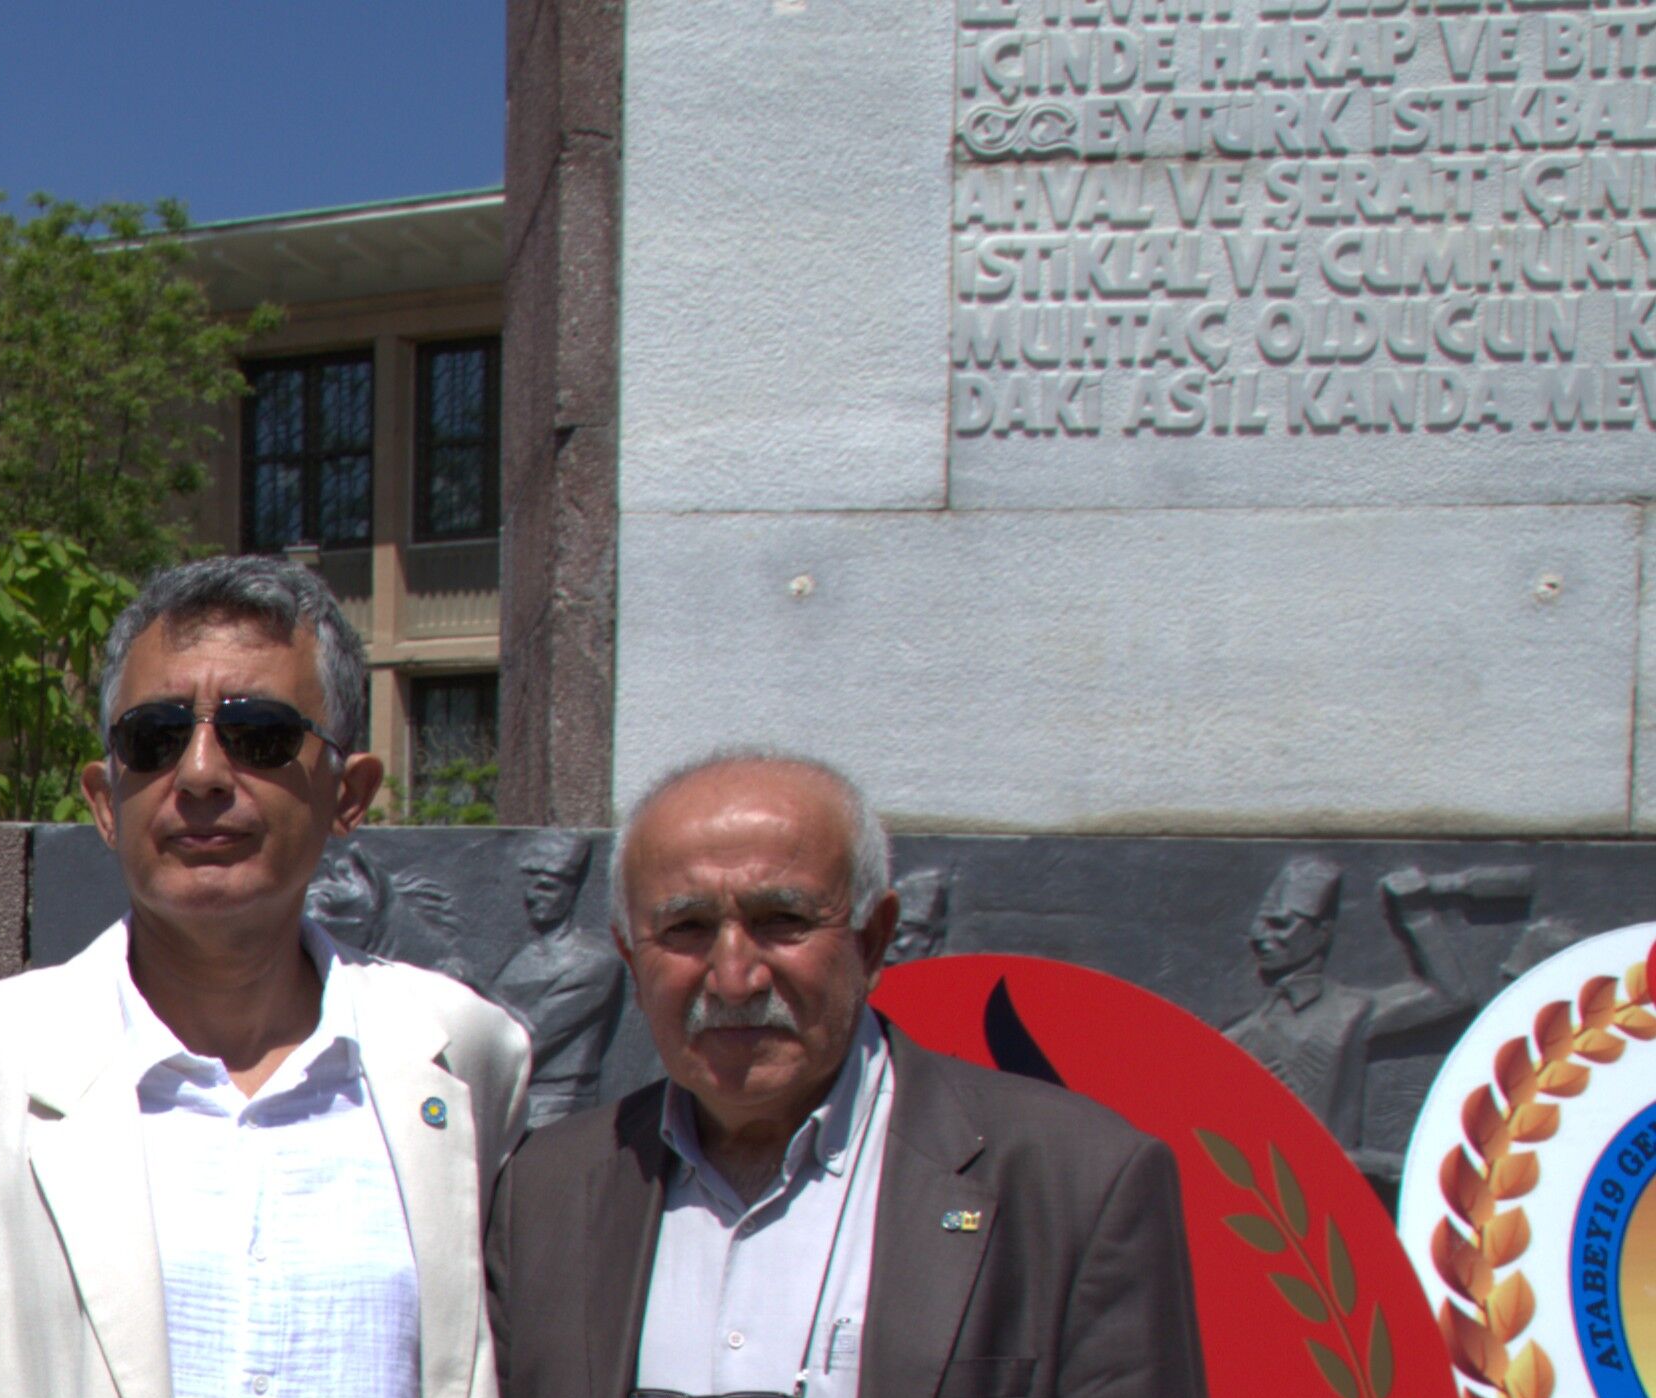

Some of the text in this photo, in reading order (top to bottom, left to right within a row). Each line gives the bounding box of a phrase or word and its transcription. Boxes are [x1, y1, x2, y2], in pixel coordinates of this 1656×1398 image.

[1199, 18, 1419, 89] HARAP
[1437, 14, 1520, 83] VE
[1084, 95, 1164, 161] EY
[951, 162, 1154, 232] AHVAL
[1165, 160, 1244, 229] VE
[1221, 228, 1300, 298] VE
[952, 301, 1230, 374] MUHTAÇ
[1121, 369, 1267, 437] ASİL
[1286, 365, 1512, 434] KANDA
[1617, 1120, 1656, 1177] GE
